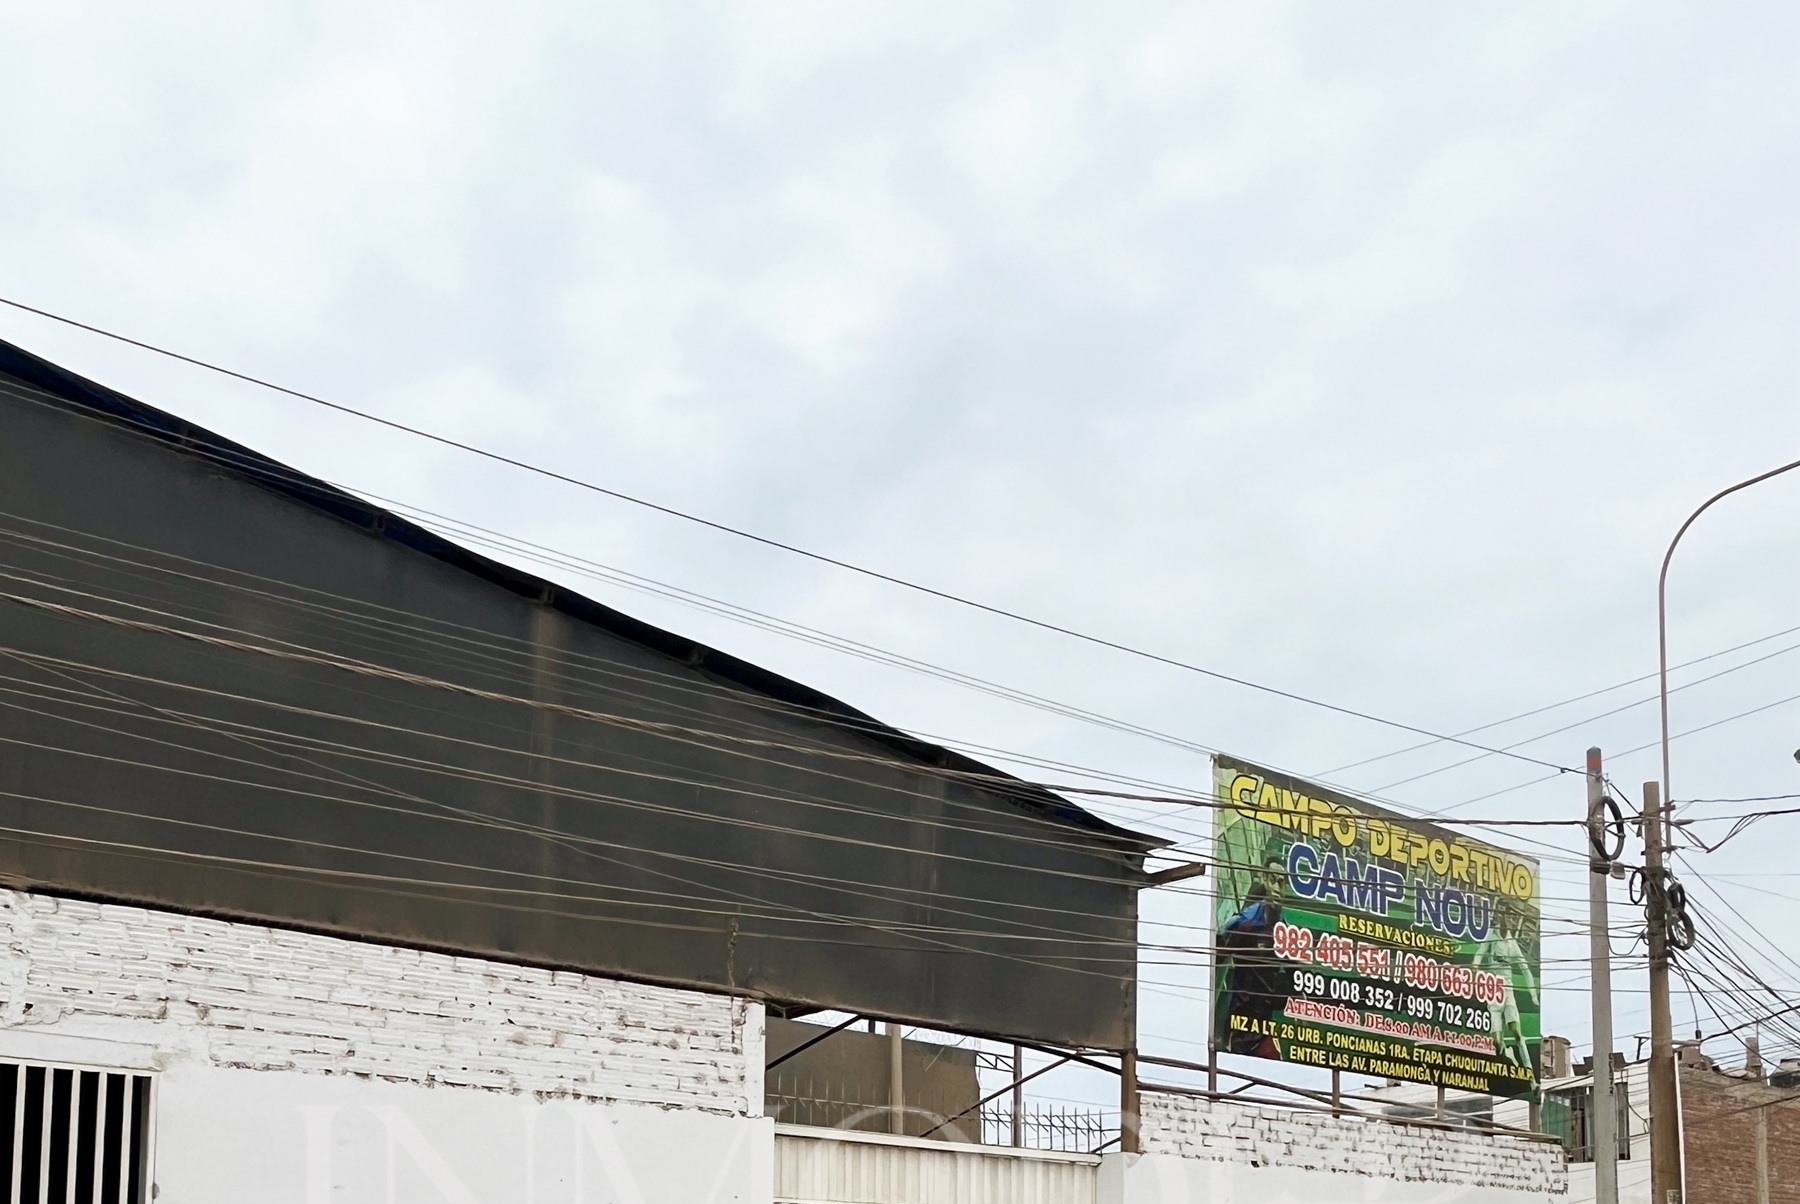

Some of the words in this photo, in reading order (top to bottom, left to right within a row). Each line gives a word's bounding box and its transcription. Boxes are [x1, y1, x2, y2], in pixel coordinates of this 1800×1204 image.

[1231, 774, 1357, 848] CAMPO
[1367, 818, 1534, 900] DEPORTIVO
[1287, 842, 1405, 918] CAMP
[1414, 879, 1490, 941] NOU
[1273, 921, 1313, 963] 982
[1315, 932, 1353, 971] 405
[1356, 942, 1391, 982] 551
[1404, 953, 1438, 991] 980
[1441, 962, 1473, 998] 663
[1476, 971, 1505, 1006] 695
[1339, 914, 1455, 955] RESERVACIONES:
[1285, 997, 1360, 1025] ATENCIÓN:
[1364, 1011, 1383, 1030] DE
[1293, 970, 1325, 996] 999
[1330, 980, 1360, 1003] 008
[1365, 986, 1394, 1010] 352
[1407, 995, 1433, 1019] 999
[1437, 1002, 1462, 1026] 702
[1466, 1008, 1491, 1032] 266
[1230, 1014, 1248, 1032] MZ
[1251, 1019, 1260, 1034] A
[1262, 1020, 1278, 1037] LT.
[1281, 1024, 1295, 1039] 26
[1298, 1027, 1324, 1045] URB.
[1327, 1032, 1386, 1056] PONCIANAS
[1389, 1043, 1411, 1060] 1RA.
[1413, 1048, 1443, 1066] ETAPA
[1445, 1053, 1508, 1078] CHUQUITANTA
[1290, 1045, 1326, 1065] ENTRE
[1329, 1052, 1350, 1069] LAS
[1352, 1057, 1367, 1072] AV.
[1370, 1060, 1431, 1083] PARAMONGA
[1432, 1069, 1440, 1084] Y
[1442, 1071, 1490, 1092] NARANJAL
